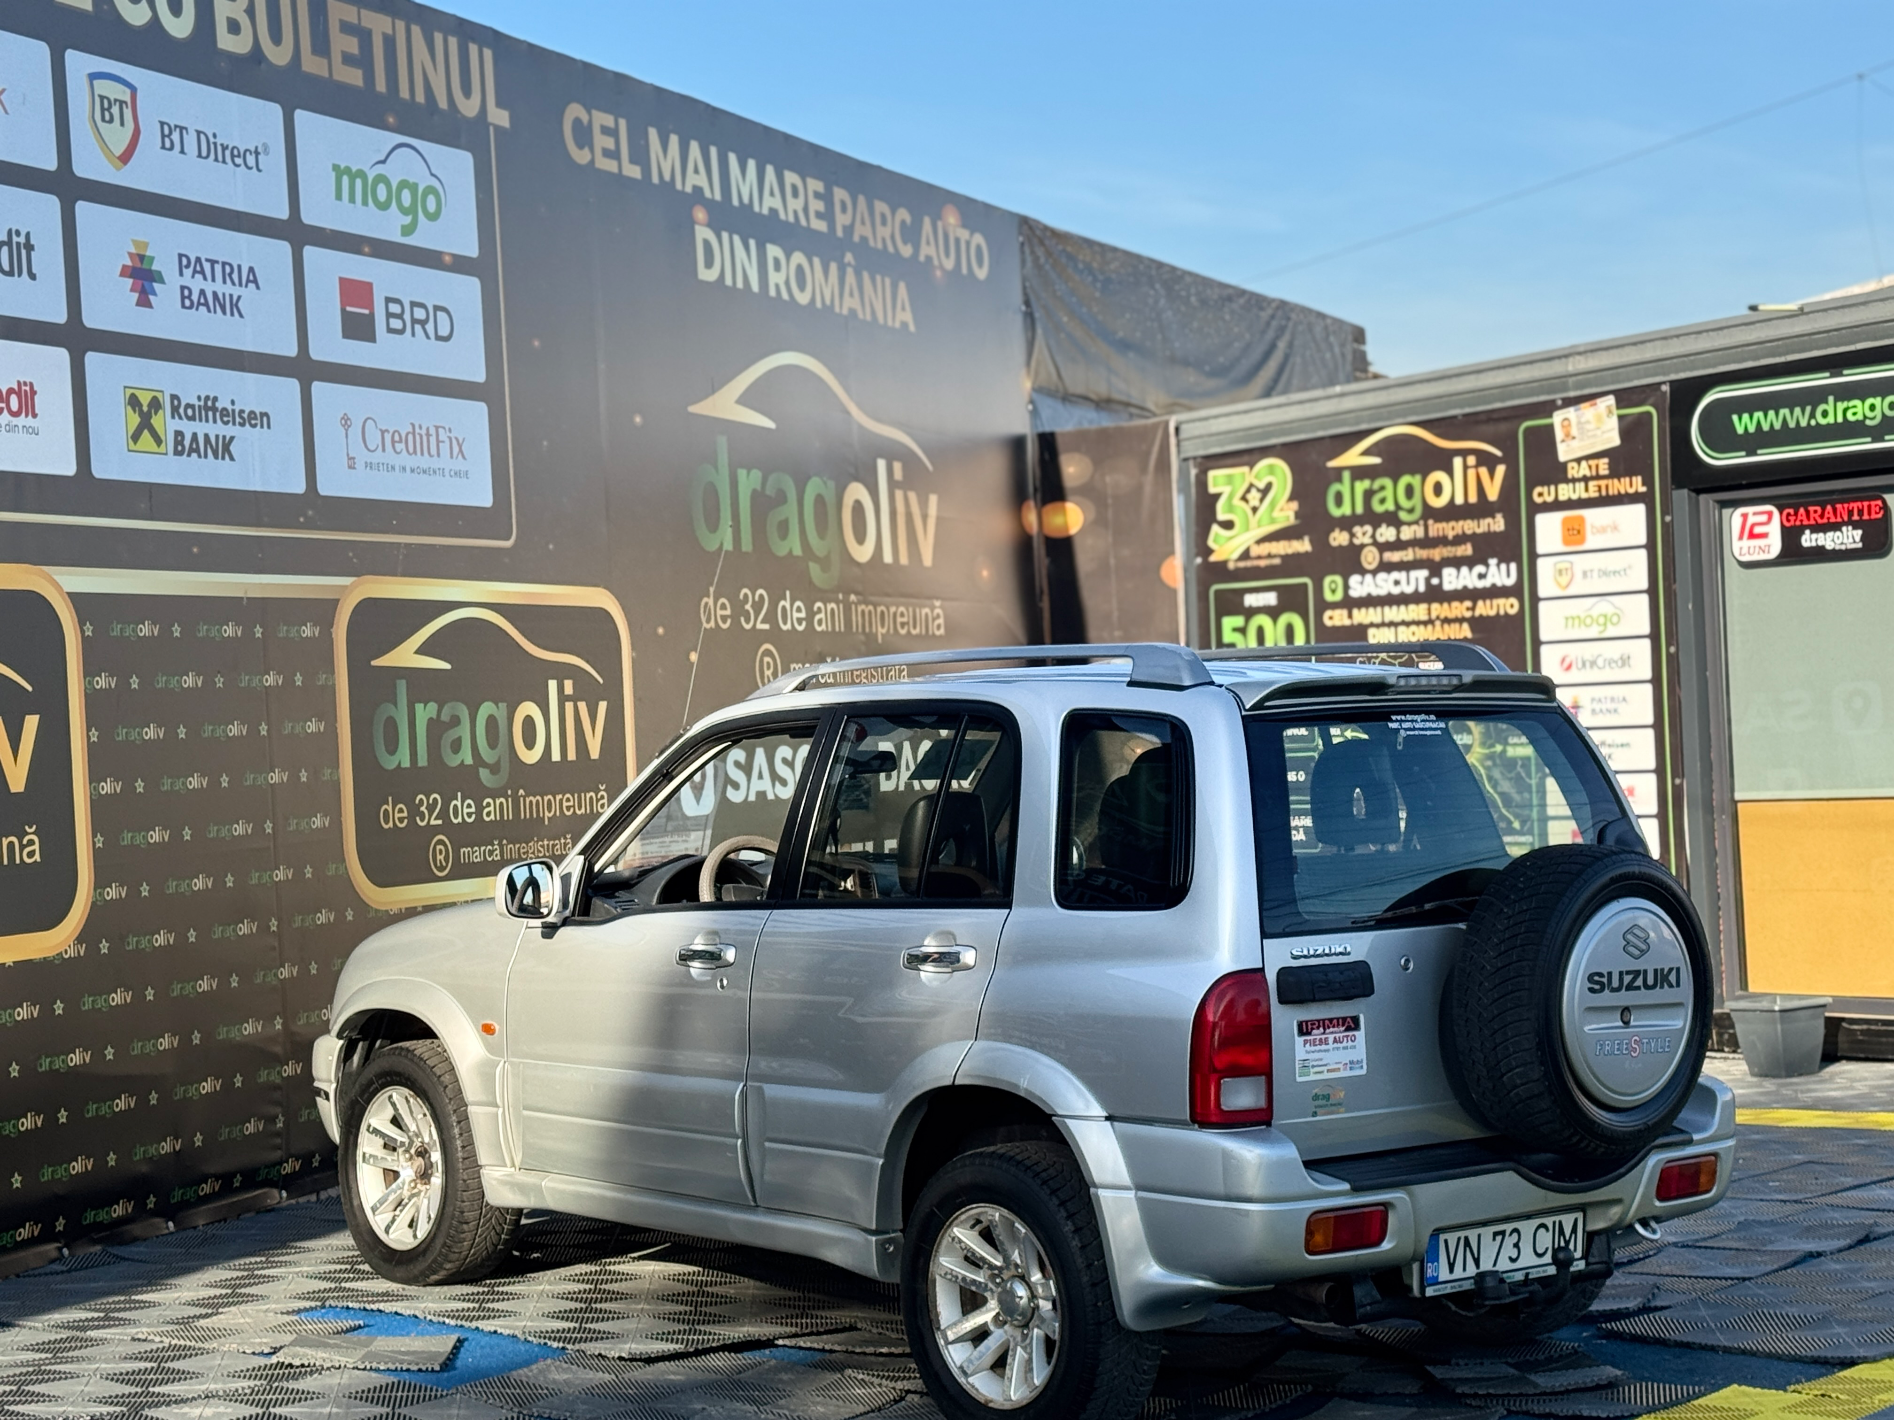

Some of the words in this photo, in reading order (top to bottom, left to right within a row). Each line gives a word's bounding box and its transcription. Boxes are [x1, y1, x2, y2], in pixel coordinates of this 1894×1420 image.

[216, 0, 510, 128] BULETINUL
[97, 94, 128, 127] BT
[158, 119, 189, 157] BT
[332, 162, 442, 237] mogo
[562, 102, 641, 180] CEL
[647, 126, 722, 201] MAI
[728, 151, 828, 232] MARE
[832, 186, 913, 259] PARC
[918, 216, 989, 281] AUTO
[177, 252, 261, 290] PATRIA
[694, 224, 760, 293] DIN
[766, 243, 915, 332] ROMÂNIA
[179, 284, 245, 320] BANK
[384, 296, 455, 343] BRD
[0, 380, 38, 419] dit
[169, 393, 271, 430] Raiffeisen
[5, 420, 20, 434] din
[22, 425, 39, 436] nou
[361, 415, 467, 462] CreditFix
[172, 430, 236, 462] BANK
[364, 460, 396, 474] PRIETEN
[409, 464, 447, 478] MOMENTE
[449, 467, 470, 480] CHEIE
[1567, 458, 1610, 479] RATE
[1207, 457, 1293, 551] 32
[1326, 455, 1506, 522] dragoliv
[1532, 486, 1556, 504] CU
[1557, 476, 1647, 502] BULETINUL
[689, 435, 939, 590] dragoliv
[1590, 521, 1620, 536] bank
[1738, 510, 1774, 542] 12
[1781, 500, 1885, 528] GARANTIE
[1329, 528, 1350, 547] de
[1352, 526, 1374, 546] 32
[1375, 524, 1397, 544] de
[1399, 520, 1424, 542] ani
[1428, 513, 1505, 542] împreună
[1801, 526, 1863, 550] dragoliv
[1738, 544, 1772, 557] LUNI
[1348, 569, 1429, 598] SASCUT
[1441, 558, 1517, 591] BACĂU
[1582, 569, 1594, 580] BT
[701, 587, 731, 630] de
[740, 587, 770, 630] 32
[777, 590, 806, 632] de
[814, 594, 845, 633] ani
[852, 597, 946, 644] împreună
[1323, 608, 1351, 627] CEL
[1352, 606, 1382, 625] MAI
[1383, 603, 1429, 623] MARE
[1430, 601, 1473, 619] PARC
[1475, 597, 1519, 616] AUTO
[1564, 612, 1621, 634] mogo
[109, 621, 159, 640] dragoliv
[196, 621, 242, 640] dragoliv
[277, 622, 320, 639] dragoliv
[1221, 611, 1306, 649] 500
[1367, 626, 1396, 645] DIN
[1397, 622, 1473, 644] ROMÂNIA
[1575, 654, 1631, 671] UniCredit
[154, 671, 203, 691] dragoliv
[238, 670, 283, 689] dragoliv
[1591, 696, 1627, 705] PATRIA
[1591, 706, 1619, 716] BANK
[114, 723, 164, 743] dragoliv
[201, 721, 247, 741] dragoliv
[282, 718, 325, 738] dragoliv
[372, 679, 608, 788] dragoliv
[160, 772, 208, 794] dragoliv
[242, 769, 288, 789] dragoliv
[380, 797, 408, 829] de
[415, 793, 443, 826] 32
[450, 792, 476, 824] de
[482, 790, 513, 821] ani
[518, 784, 609, 825] împreună
[119, 826, 170, 847] dragoliv
[206, 820, 253, 840] dragoliv
[287, 813, 330, 833] dragoliv
[460, 846, 500, 864] marcă
[503, 834, 573, 860] înregistrată
[164, 874, 213, 895] dragoliv
[248, 865, 293, 886] dragoliv
[125, 930, 175, 952] dragoliv
[211, 919, 257, 940] dragoliv
[292, 908, 335, 929] dragoliv
[1290, 944, 1351, 960] SUZUKI
[80, 989, 133, 1011] dragoliv
[169, 976, 218, 999] dragoliv
[1586, 966, 1680, 994] SUZUKI
[1302, 1017, 1355, 1033] IRIMIA
[1303, 1036, 1330, 1048] PIESE
[1332, 1034, 1357, 1045] AUTO
[37, 1048, 91, 1073] dragoliv
[129, 1033, 179, 1055] dragoliv
[216, 1018, 263, 1040] dragoliv
[84, 1095, 136, 1119] dragoliv
[172, 1077, 222, 1100] dragoliv
[256, 1061, 302, 1083] dragoliv
[39, 1156, 93, 1182] dragoliv
[82, 1200, 134, 1225] dragoliv
[1444, 1233, 1482, 1275] VN
[1492, 1228, 1521, 1268] 73
[1532, 1217, 1579, 1258] CIM
[1426, 1262, 1438, 1278] RO
